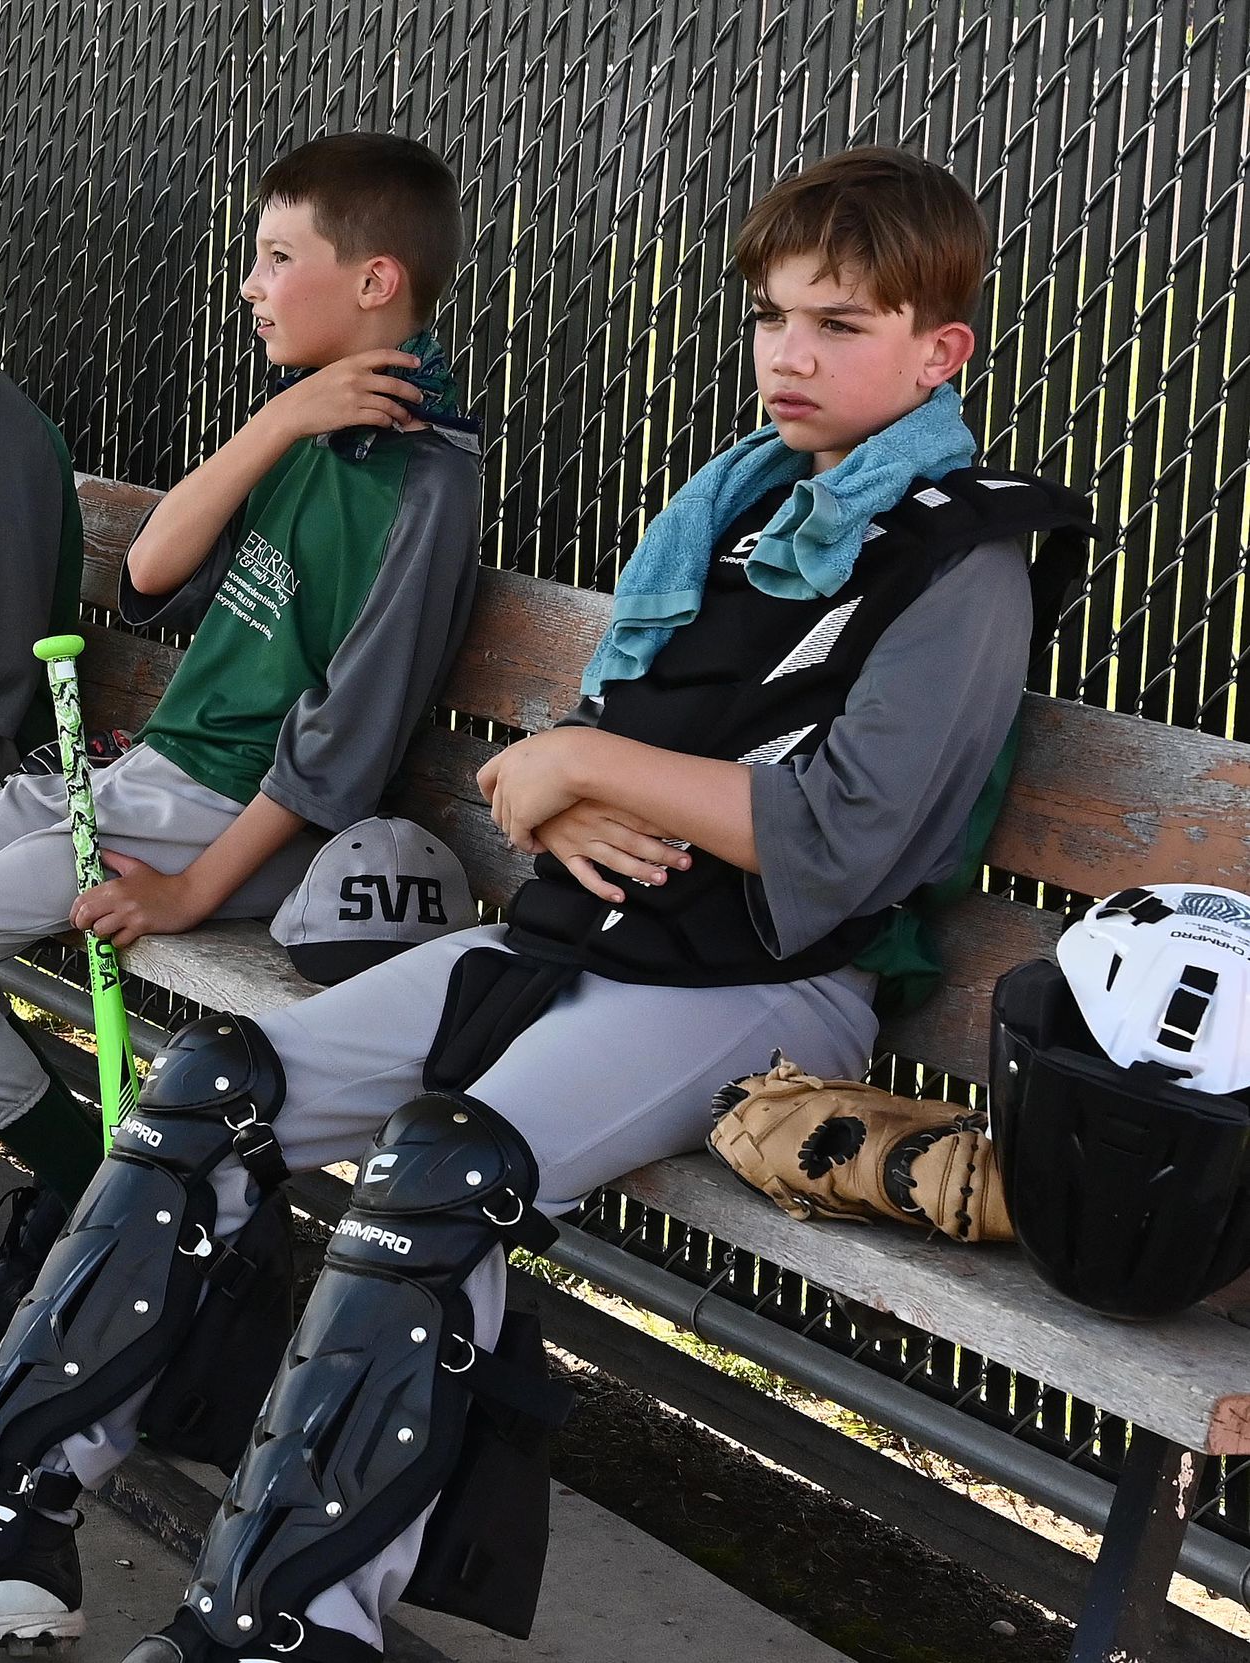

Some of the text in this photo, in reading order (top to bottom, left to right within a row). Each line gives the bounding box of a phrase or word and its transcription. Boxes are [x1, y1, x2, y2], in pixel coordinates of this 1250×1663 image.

[338, 874, 448, 925] SVB
[1170, 931, 1245, 956] CHAMPRO
[335, 1219, 413, 1255] CHAMPRO
